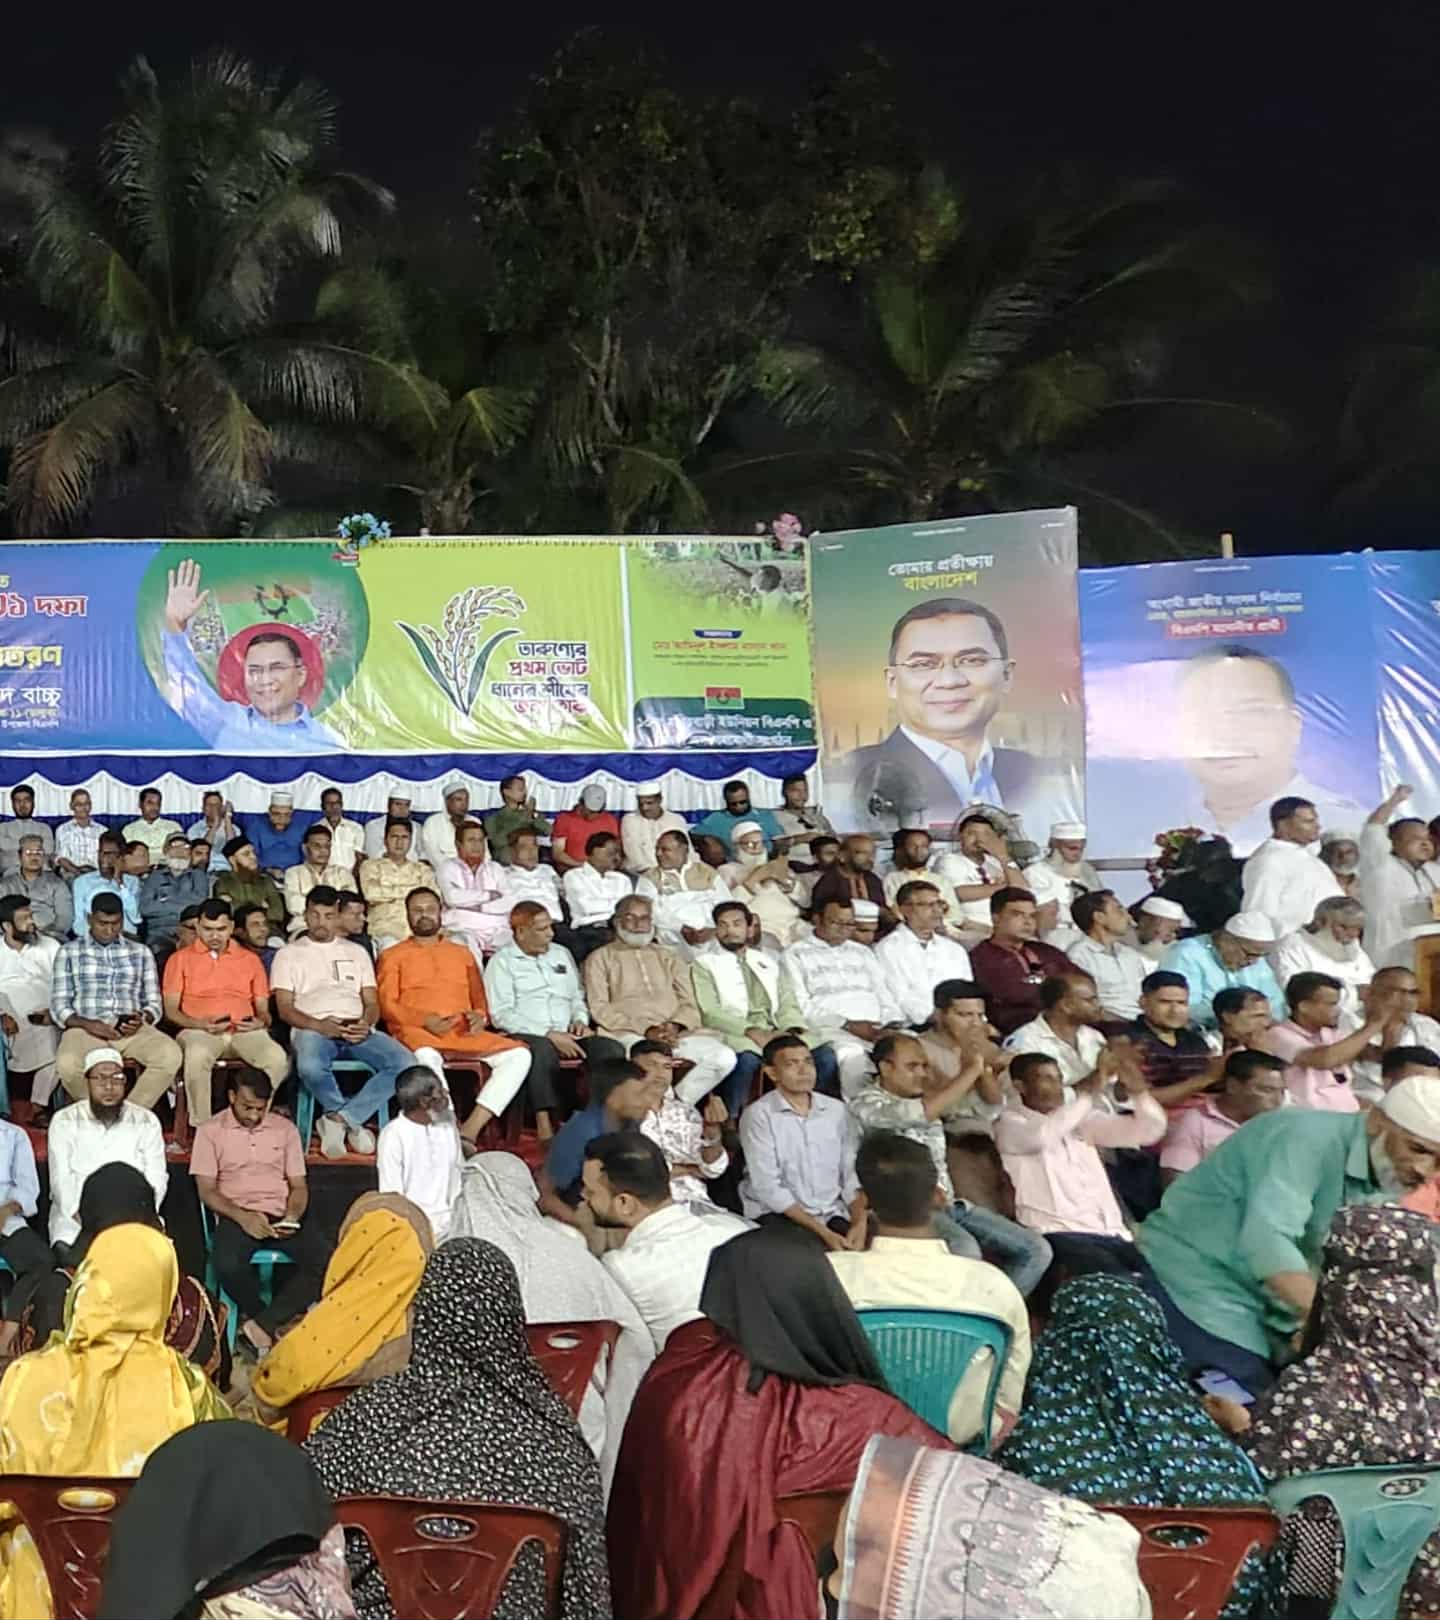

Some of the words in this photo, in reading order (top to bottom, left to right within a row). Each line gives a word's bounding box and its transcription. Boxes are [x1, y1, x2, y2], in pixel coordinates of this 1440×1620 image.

[888, 561, 934, 576] তোমার
[938, 554, 994, 571] প্রতীক্ষায়
[903, 572, 977, 591] বাংলাদেশ
[33, 595, 88, 617] দফা
[518, 642, 586, 658] তারুণ্যের
[509, 661, 547, 676] প্রথম
[551, 658, 588, 675] ভোট
[20, 685, 63, 708] বাচ্চু
[491, 682, 537, 697] ধানের
